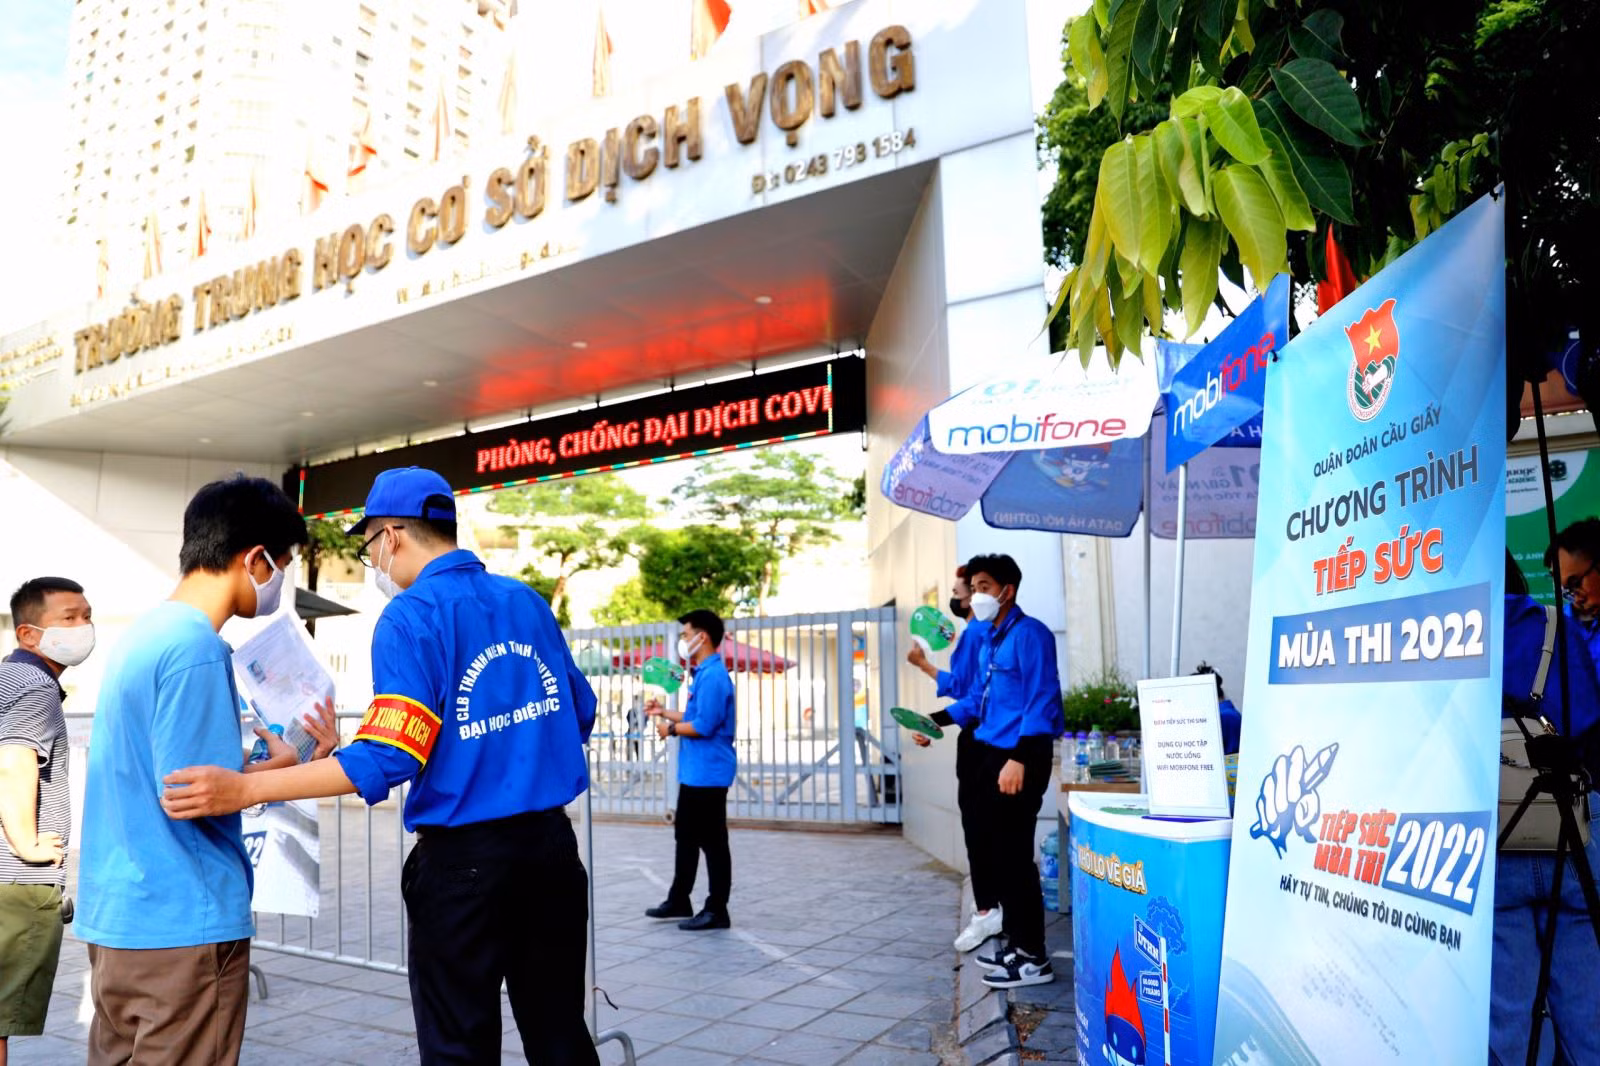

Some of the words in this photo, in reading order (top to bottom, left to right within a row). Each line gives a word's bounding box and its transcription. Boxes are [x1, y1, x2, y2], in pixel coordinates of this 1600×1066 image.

[193, 248, 303, 334] TRUNG
[312, 213, 396, 297] HỌC
[407, 174, 472, 255] CƠ
[485, 135, 549, 228] SỞ
[567, 97, 702, 205] DỊCH
[725, 25, 916, 148] VỌNG
[784, 154, 829, 184] 0243
[833, 142, 868, 170] 793
[872, 128, 916, 158] 1584
[1173, 331, 1275, 436] mobifone
[476, 431, 556, 474] PHÒNG,
[559, 419, 640, 459] CHỐNG
[644, 416, 690, 446] ĐẠI
[693, 398, 760, 438] DỊCH
[948, 412, 1127, 447] mobifone
[1313, 449, 1343, 478] QUẬN
[1345, 436, 1378, 465] ĐOÀN
[1381, 422, 1407, 449] CẦU
[1411, 403, 1442, 434] GIẤY
[1286, 480, 1386, 542] CHƯƠNG
[1394, 443, 1479, 508] TRÌNH
[1313, 536, 1367, 595] TIẾP
[1374, 524, 1443, 584] SỨC
[1278, 621, 1336, 669] MÙA
[1344, 622, 1392, 664] THI
[1400, 609, 1484, 661] 2022
[459, 652, 489, 692] THANH
[371, 706, 408, 732] XUNG
[404, 715, 432, 747] KÍCH
[456, 696, 470, 721] CLB
[459, 719, 488, 740] ĐẠI
[488, 712, 511, 732] HỌC
[1320, 811, 1358, 843] TIẾP
[1106, 854, 1122, 885] VỀ
[1122, 861, 1147, 893] GIÁ
[1354, 849, 1386, 886] THI
[1386, 820, 1485, 904] 2022
[1280, 875, 1298, 894] HÃY
[1300, 878, 1313, 901] TỰ
[1314, 884, 1330, 908] TIN,
[1332, 889, 1369, 917] CHÚNG
[1372, 900, 1389, 925] TÔI
[1391, 911, 1401, 929] ĐI
[1404, 911, 1437, 940] CÙNG
[1440, 927, 1462, 952] BẠN
